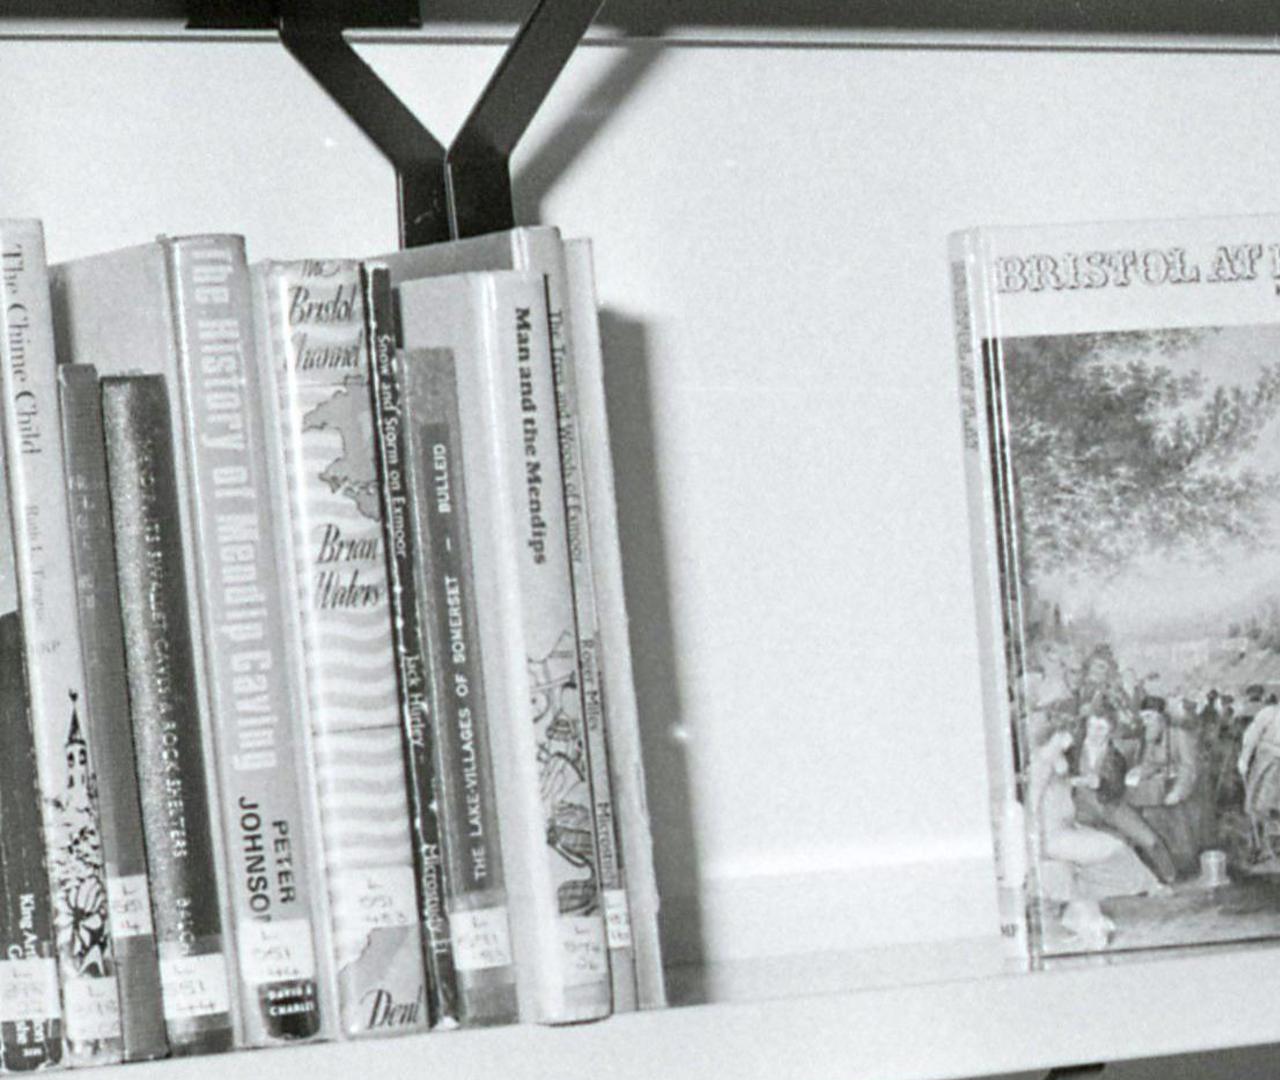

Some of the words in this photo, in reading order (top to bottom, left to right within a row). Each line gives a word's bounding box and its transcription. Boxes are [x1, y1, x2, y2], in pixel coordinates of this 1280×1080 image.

[1, 244, 24, 294] The
[191, 248, 235, 304] The
[997, 247, 1201, 293] BRISTOL
[1205, 243, 1263, 283] AT
[288, 284, 358, 326] Bristol
[8, 303, 31, 383] Chime
[377, 334, 391, 375] Snow
[515, 307, 532, 363] Man
[197, 318, 250, 452] History
[380, 383, 396, 410] and
[518, 366, 536, 413] and
[15, 391, 42, 455] Child
[384, 417, 399, 465] Storm
[522, 415, 539, 456] the
[212, 465, 255, 500] of
[388, 472, 401, 490] on
[433, 444, 451, 514] BULLEID
[392, 497, 407, 559] Exmoor
[525, 460, 547, 566] Mendips
[315, 523, 379, 565] Brian
[215, 514, 267, 641] Mendip
[315, 569, 384, 610] Waters
[444, 575, 467, 664] SOMERSET
[404, 654, 420, 686] Jack
[454, 674, 469, 698] OF
[230, 650, 278, 771] Caving
[408, 692, 426, 748] Hurley
[163, 721, 182, 774] ROCK
[457, 707, 483, 838] LAKE-VILLAGES
[165, 777, 188, 858] SHELTERS
[272, 819, 296, 904] PETER
[471, 858, 488, 881] THE
[420, 843, 442, 934] Microstudy
[360, 984, 423, 1030] Dent
